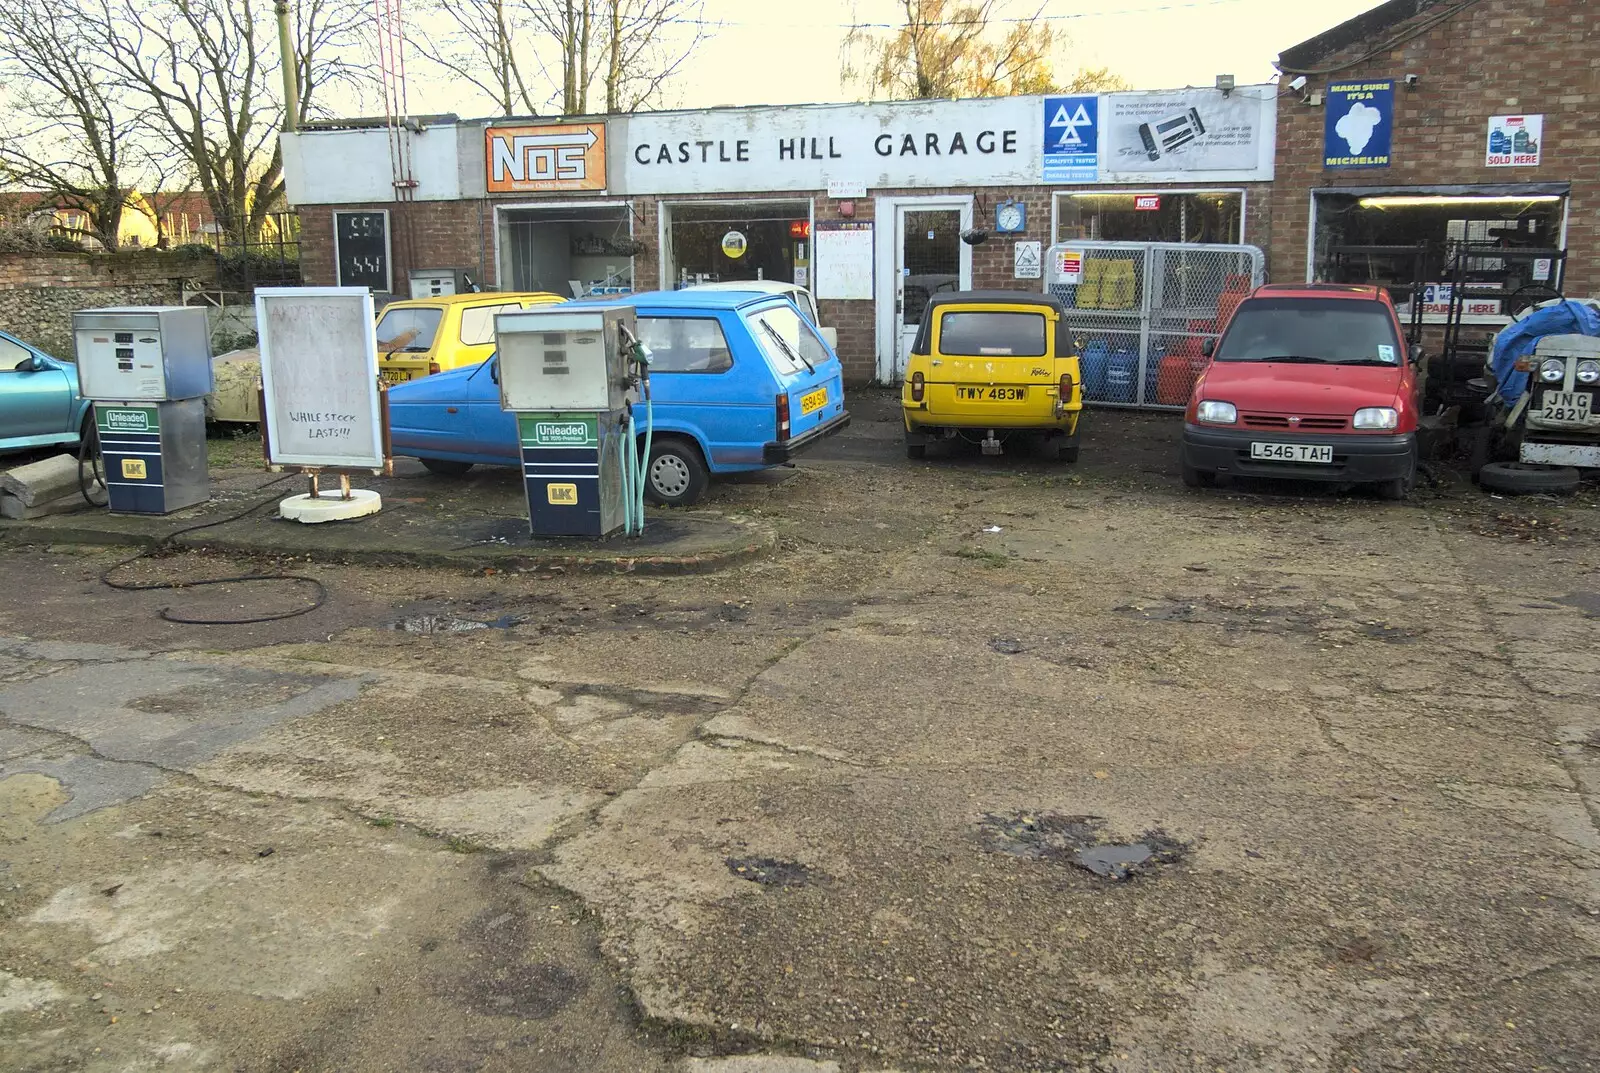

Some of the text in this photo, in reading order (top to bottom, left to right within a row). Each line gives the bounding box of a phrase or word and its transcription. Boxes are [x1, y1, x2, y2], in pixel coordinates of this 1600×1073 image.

[1362, 83, 1390, 91] SURE
[635, 130, 1017, 165] CASTLE HILL GARAGE
[492, 132, 590, 182] NOS
[1326, 156, 1388, 165] MICHELIN
[1488, 154, 1537, 164] SOLD HERE
[1417, 304, 1495, 313] EPAIRE HERE
[957, 387, 1025, 400] TWY 483W
[1549, 393, 1588, 408] JNG
[109, 413, 146, 422] Unleaded
[289, 411, 356, 423] WHILE STOCK
[1545, 407, 1588, 420] 282V
[308, 427, 351, 439] LASTS!!!
[539, 425, 585, 435] Unleaded
[1252, 444, 1331, 460] L546 TAH
